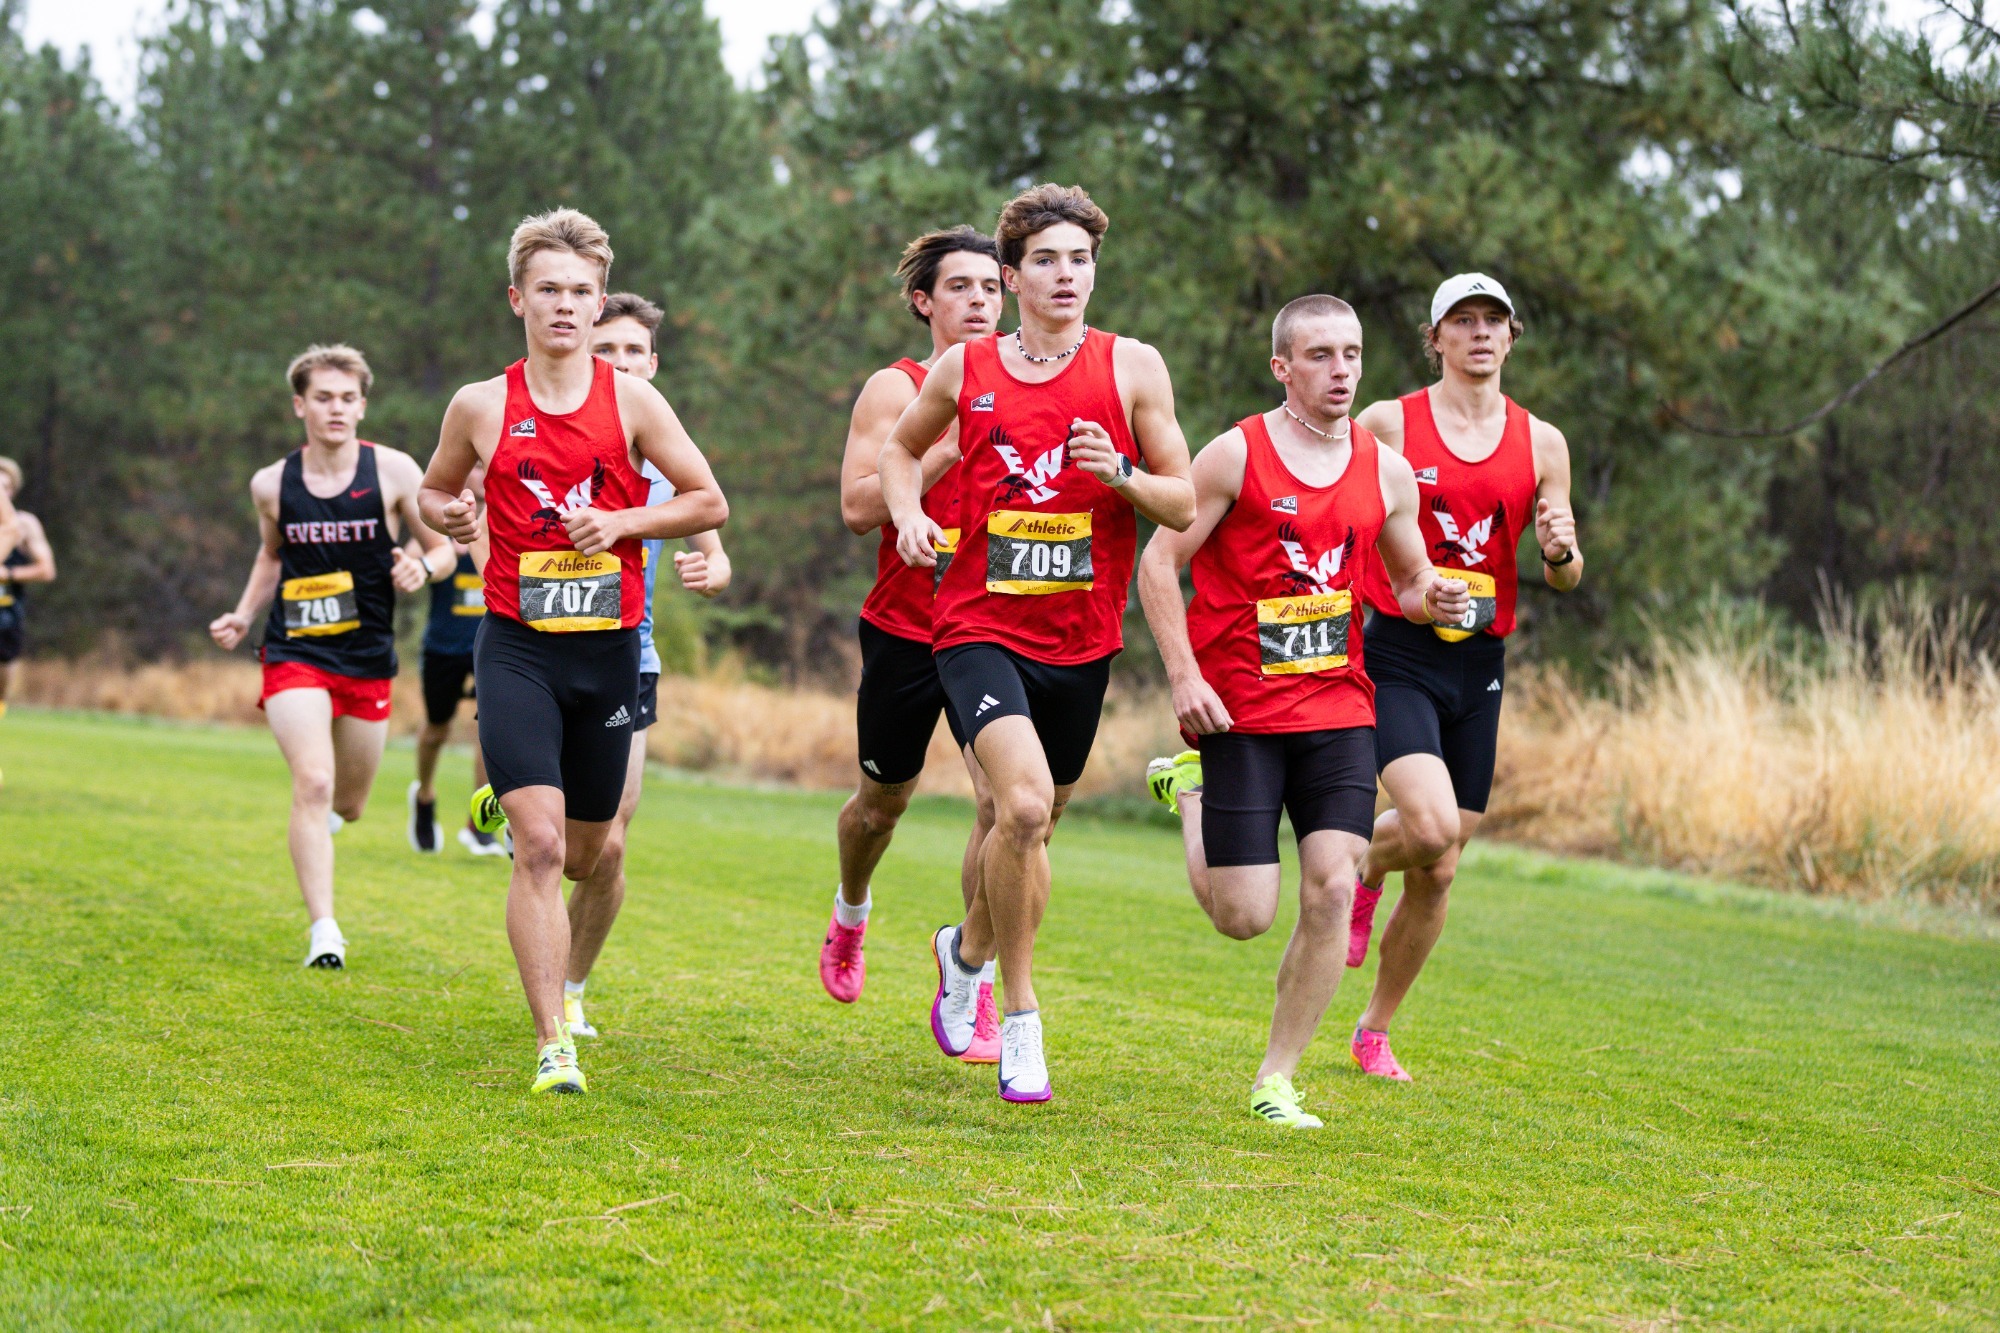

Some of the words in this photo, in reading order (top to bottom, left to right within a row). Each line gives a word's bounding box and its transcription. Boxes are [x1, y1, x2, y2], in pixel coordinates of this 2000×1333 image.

[520, 475, 592, 516] EW
[286, 518, 378, 544] EVERETT
[1007, 518, 1076, 534] Athletic
[538, 558, 603, 572] Athletic
[1011, 543, 1070, 577] 709
[543, 581, 599, 613] 707
[1277, 602, 1336, 618] Athletic
[298, 597, 341, 626] 740
[1283, 622, 1332, 656] 711
[605, 716, 630, 727] adidas
